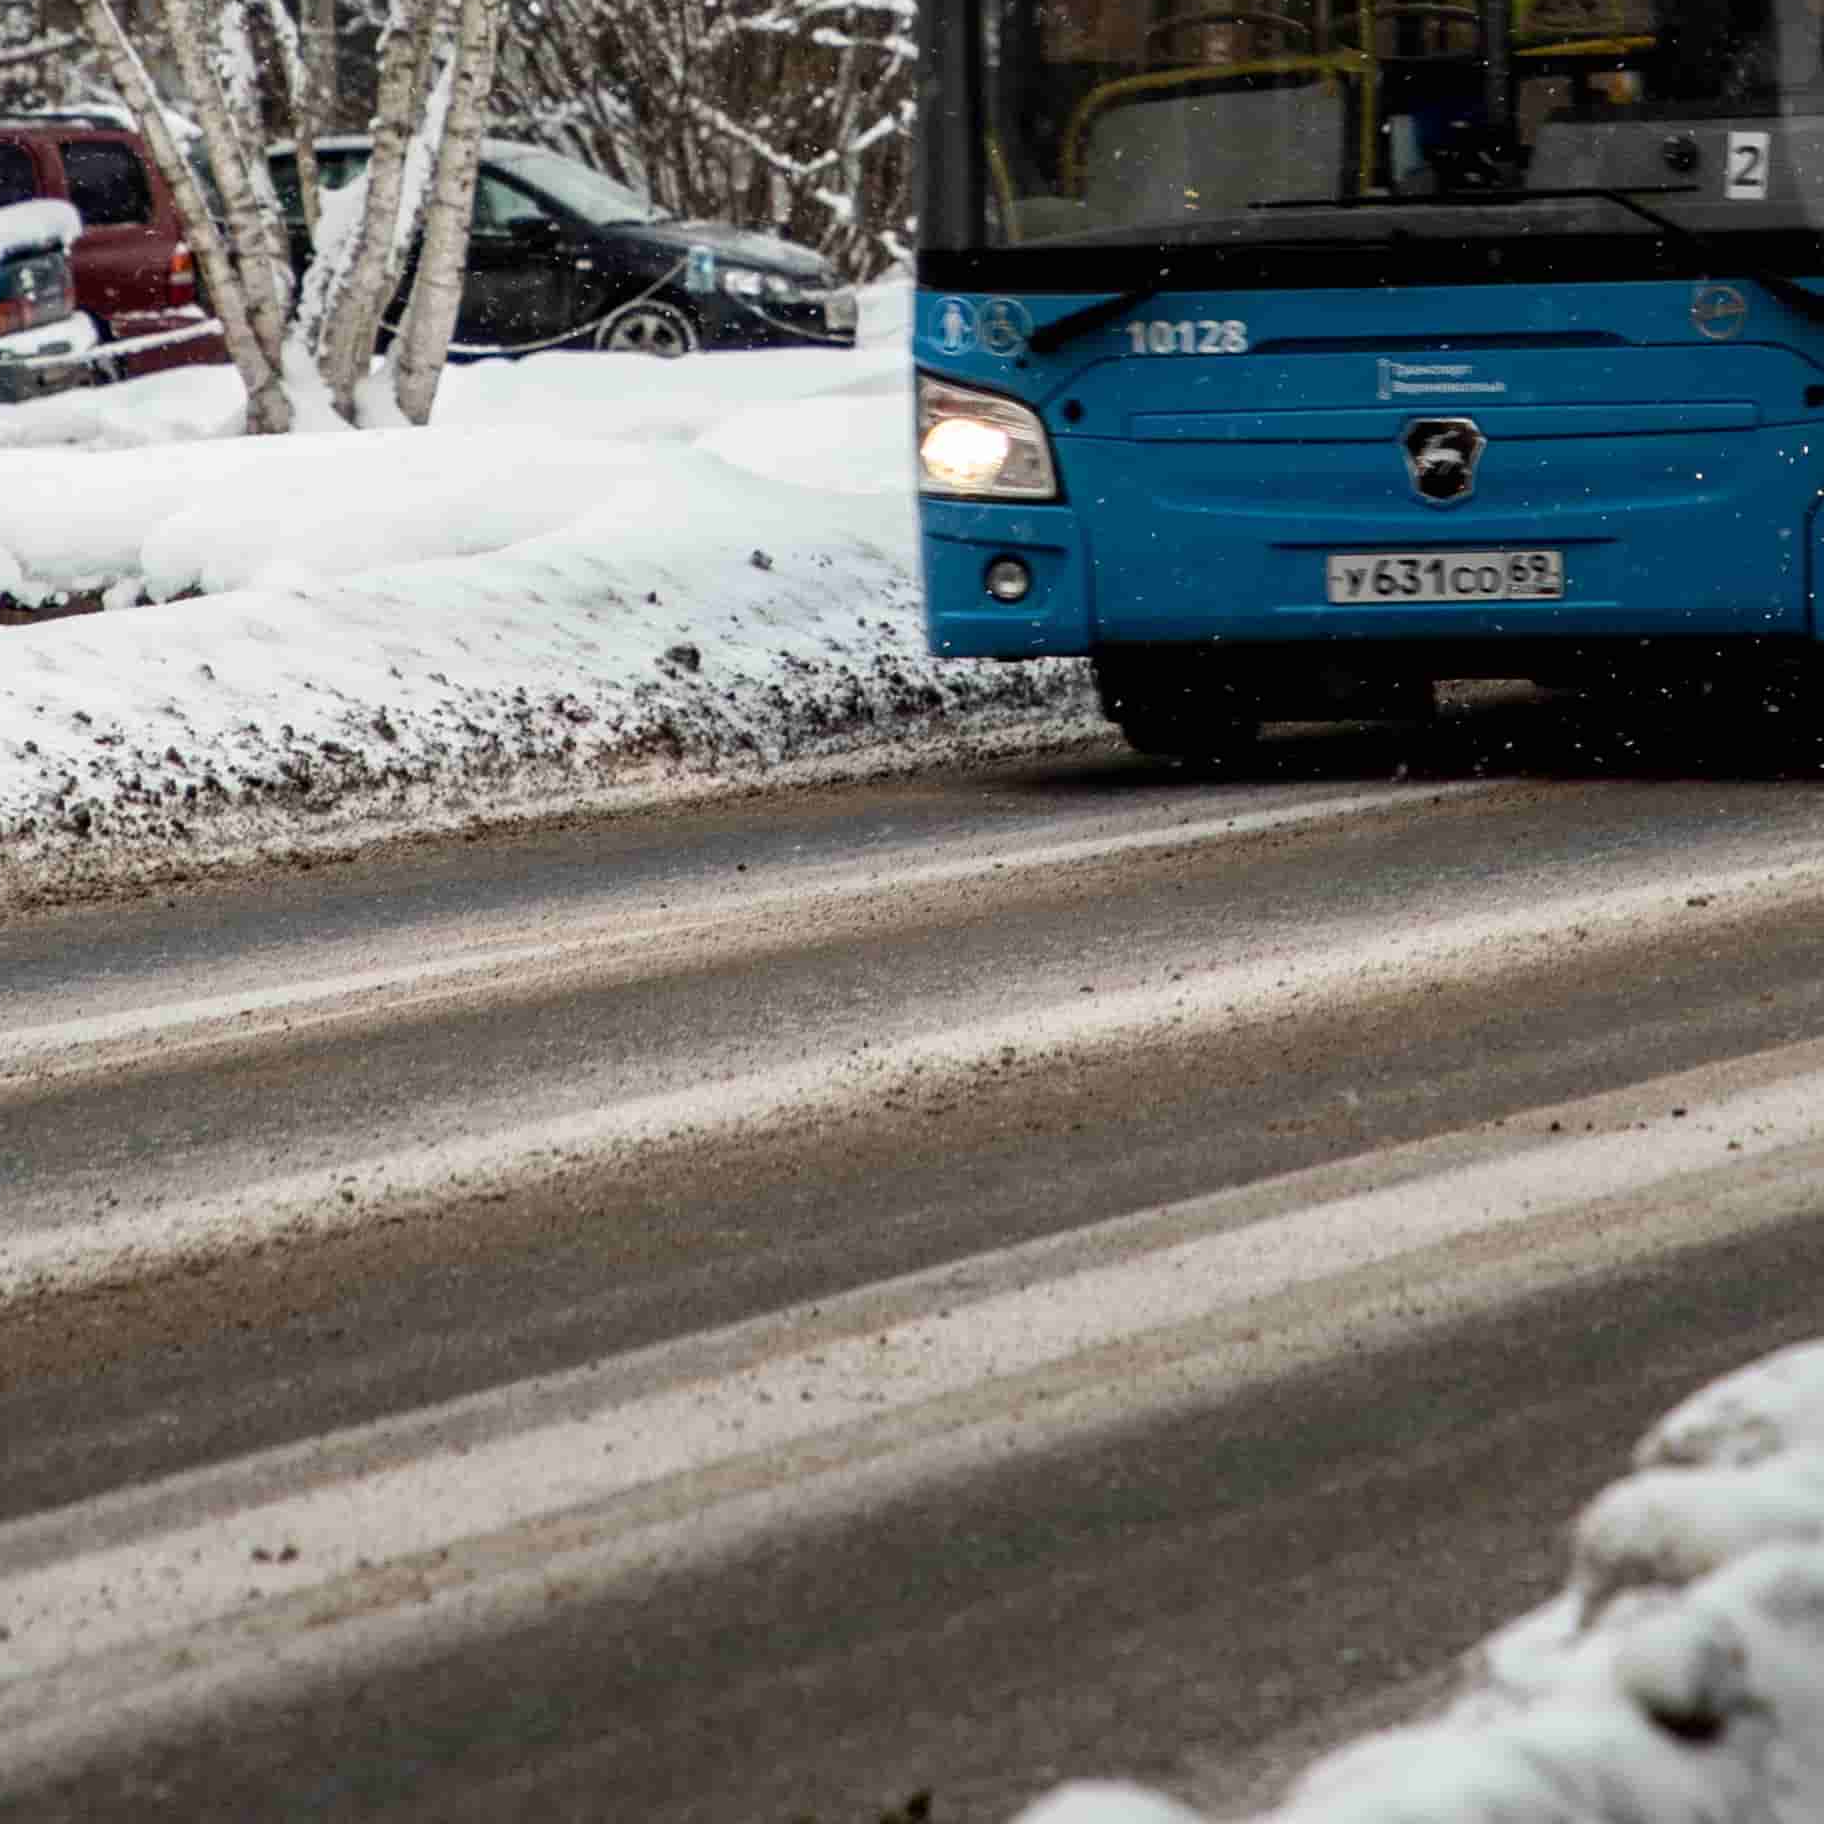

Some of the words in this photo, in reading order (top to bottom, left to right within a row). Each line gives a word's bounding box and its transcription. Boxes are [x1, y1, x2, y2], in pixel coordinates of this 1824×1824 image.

[1732, 144, 1762, 187] 2
[1126, 319, 1250, 354] 10128
[1508, 553, 1551, 583] 69
